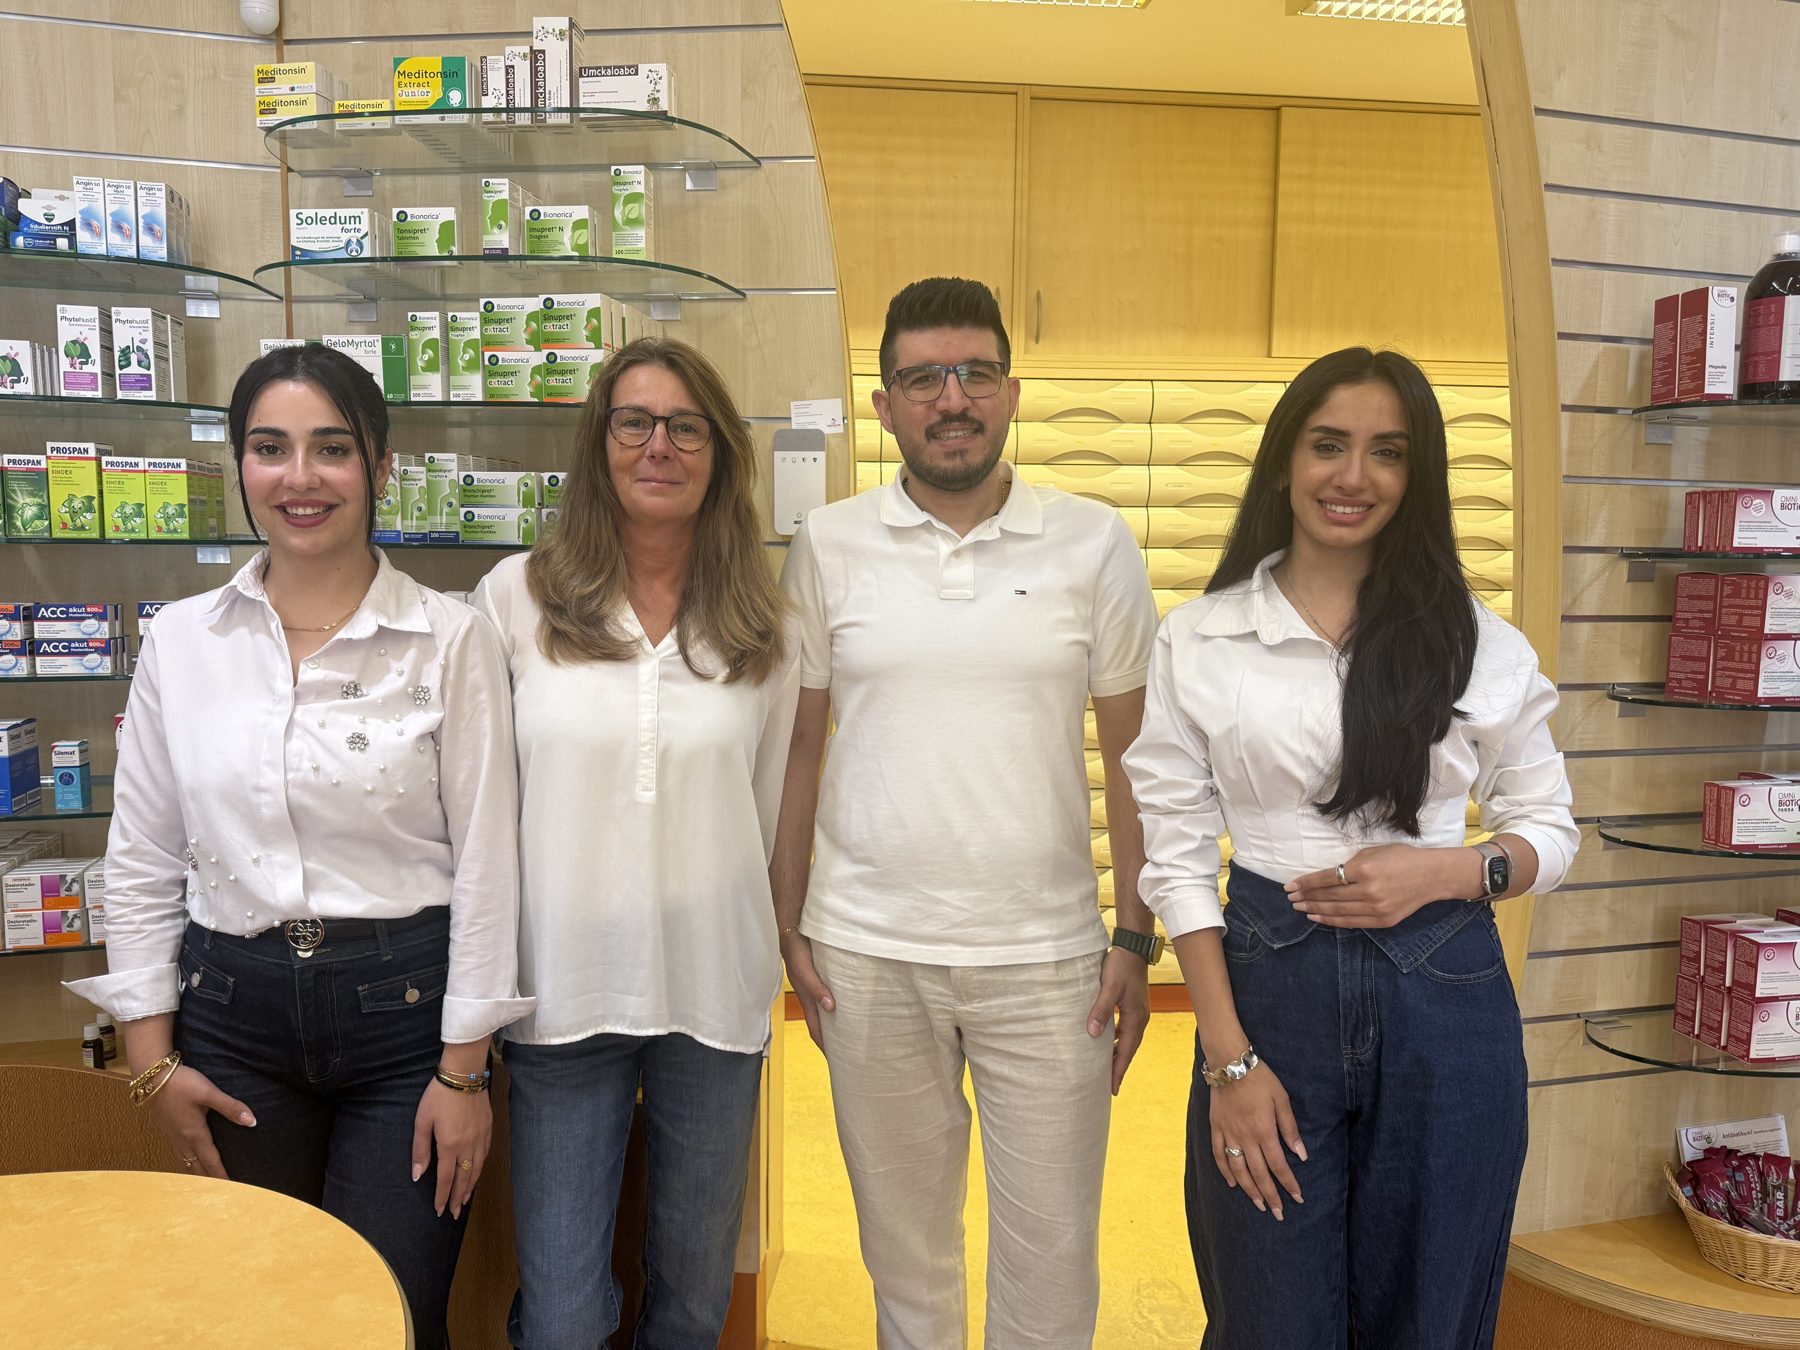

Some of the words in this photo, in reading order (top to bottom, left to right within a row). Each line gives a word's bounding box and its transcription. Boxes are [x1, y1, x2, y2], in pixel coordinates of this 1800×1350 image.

[257, 66, 306, 77] Meditonsin
[397, 69, 459, 79] Meditonsin
[582, 66, 635, 77] Umckaloabo
[258, 98, 307, 108] Meditonsin
[338, 101, 383, 110] Meditonsin
[296, 211, 362, 226] Soledum
[483, 316, 513, 325] Sinupret
[543, 314, 573, 322] Sinupret
[326, 338, 376, 350] GeloMyrtol
[559, 354, 589, 362] Bionorica
[488, 370, 518, 378] Sinupret
[546, 367, 576, 376] Sinupret
[50, 446, 89, 455] PROSPAN
[7, 458, 42, 466] PROSPAN
[105, 460, 139, 469] PROSPAN
[148, 461, 181, 469] PROSPAN
[1780, 502, 1800, 511] BiOTi
[37, 607, 68, 618] ACC
[142, 605, 162, 615] AC
[39, 642, 70, 653] ACC
